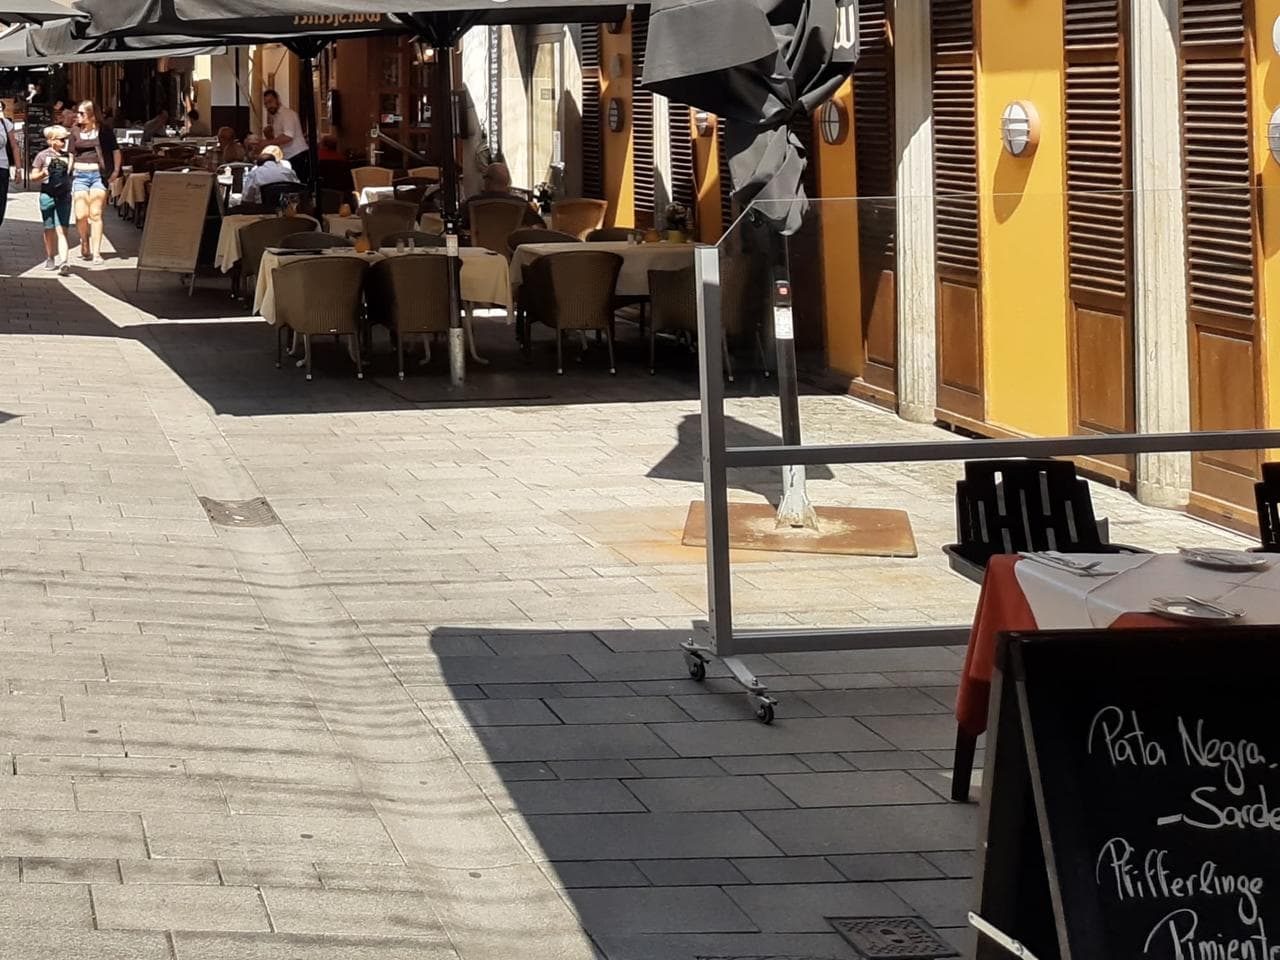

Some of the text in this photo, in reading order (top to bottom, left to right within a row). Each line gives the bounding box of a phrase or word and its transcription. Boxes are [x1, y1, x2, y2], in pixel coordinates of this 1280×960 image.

[1088, 705, 1266, 796] Pata Negra
[1096, 837, 1264, 925] Pfifferlinge
